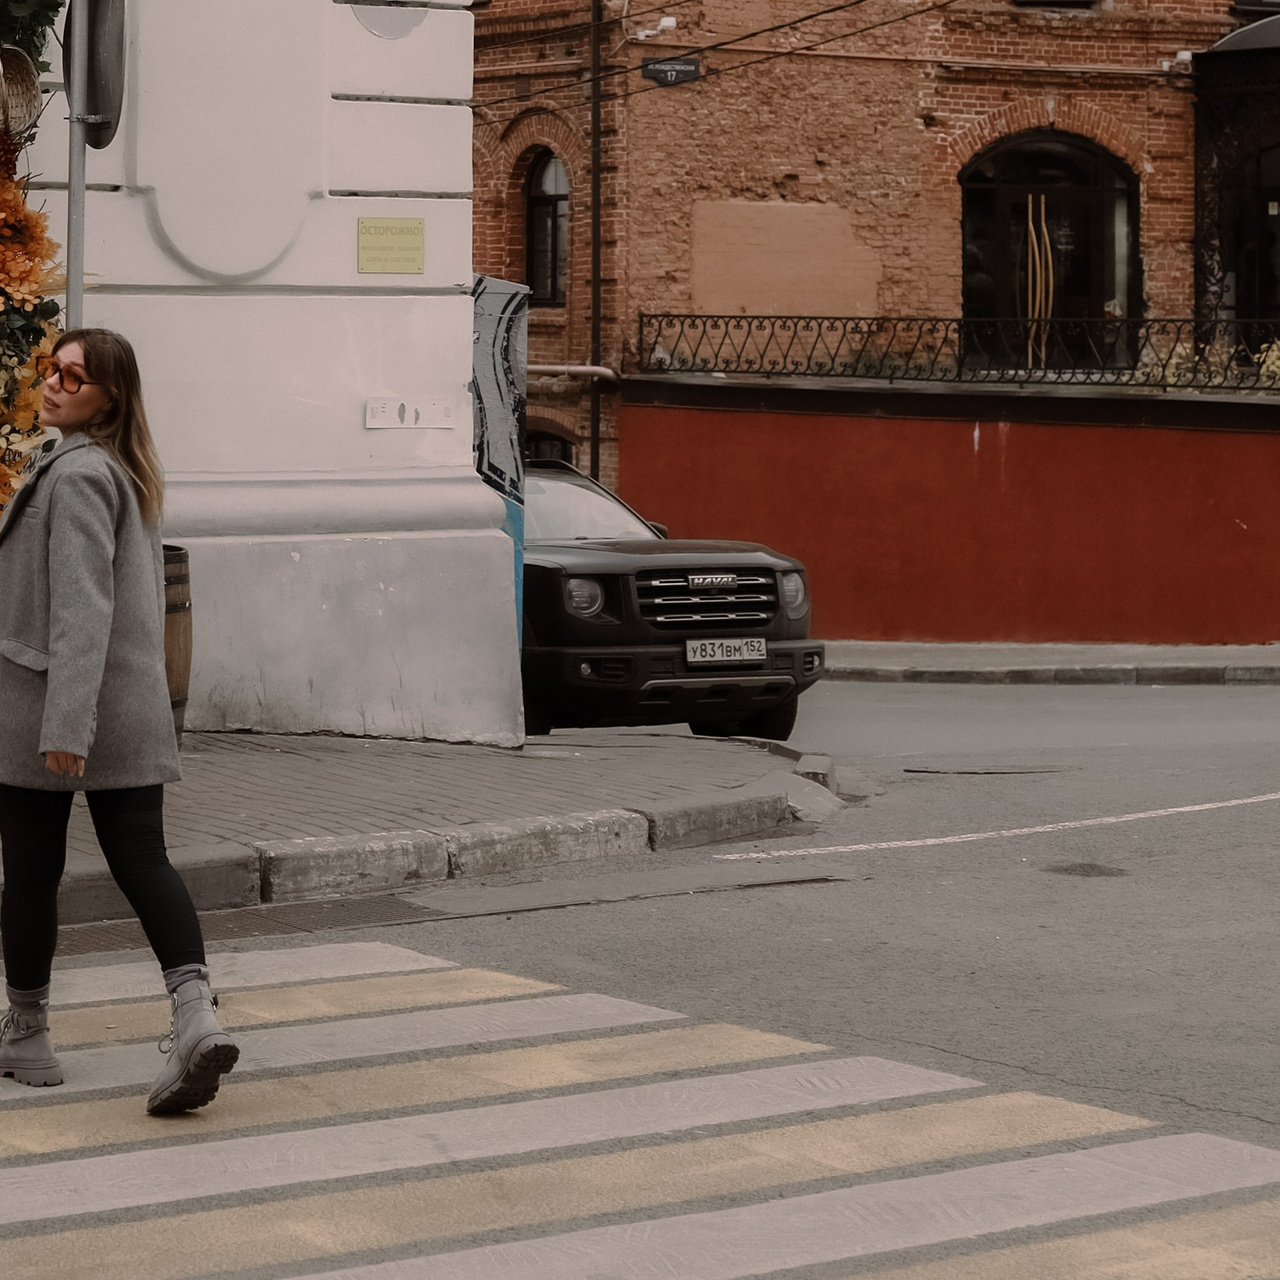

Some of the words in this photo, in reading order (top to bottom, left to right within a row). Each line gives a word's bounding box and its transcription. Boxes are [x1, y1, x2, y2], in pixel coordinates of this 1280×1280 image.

[667, 71, 677, 81] 17
[693, 577, 736, 586] HAVAL
[744, 640, 763, 653] 152
